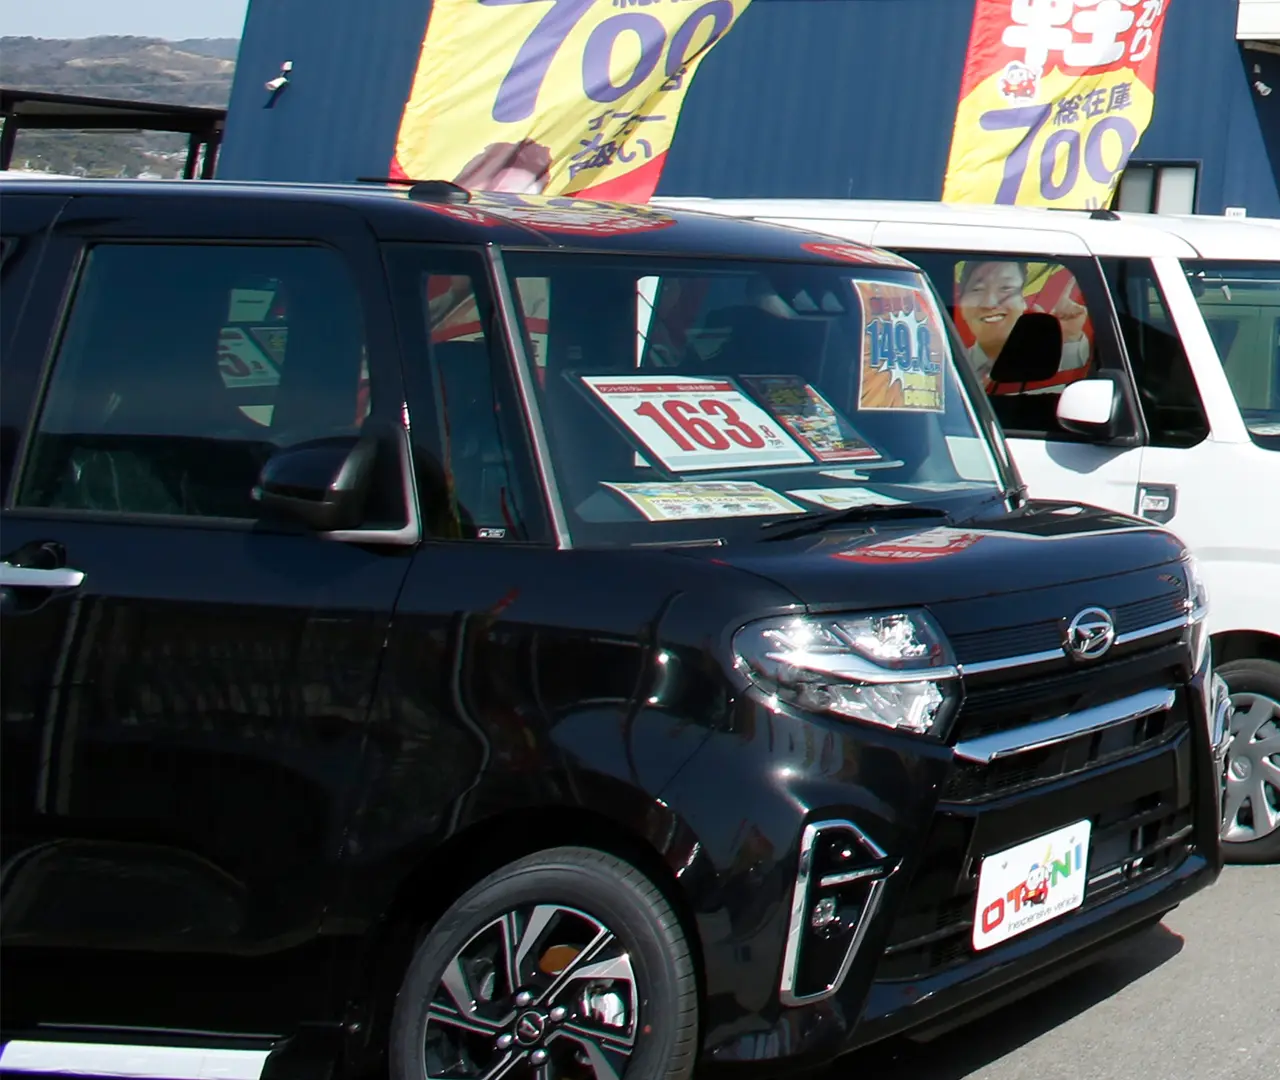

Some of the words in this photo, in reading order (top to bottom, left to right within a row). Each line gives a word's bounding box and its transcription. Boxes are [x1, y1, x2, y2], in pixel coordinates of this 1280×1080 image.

[1052, 81, 1134, 126] 総在庫
[979, 102, 1138, 205] 700
[982, 843, 1082, 934] OTNI
